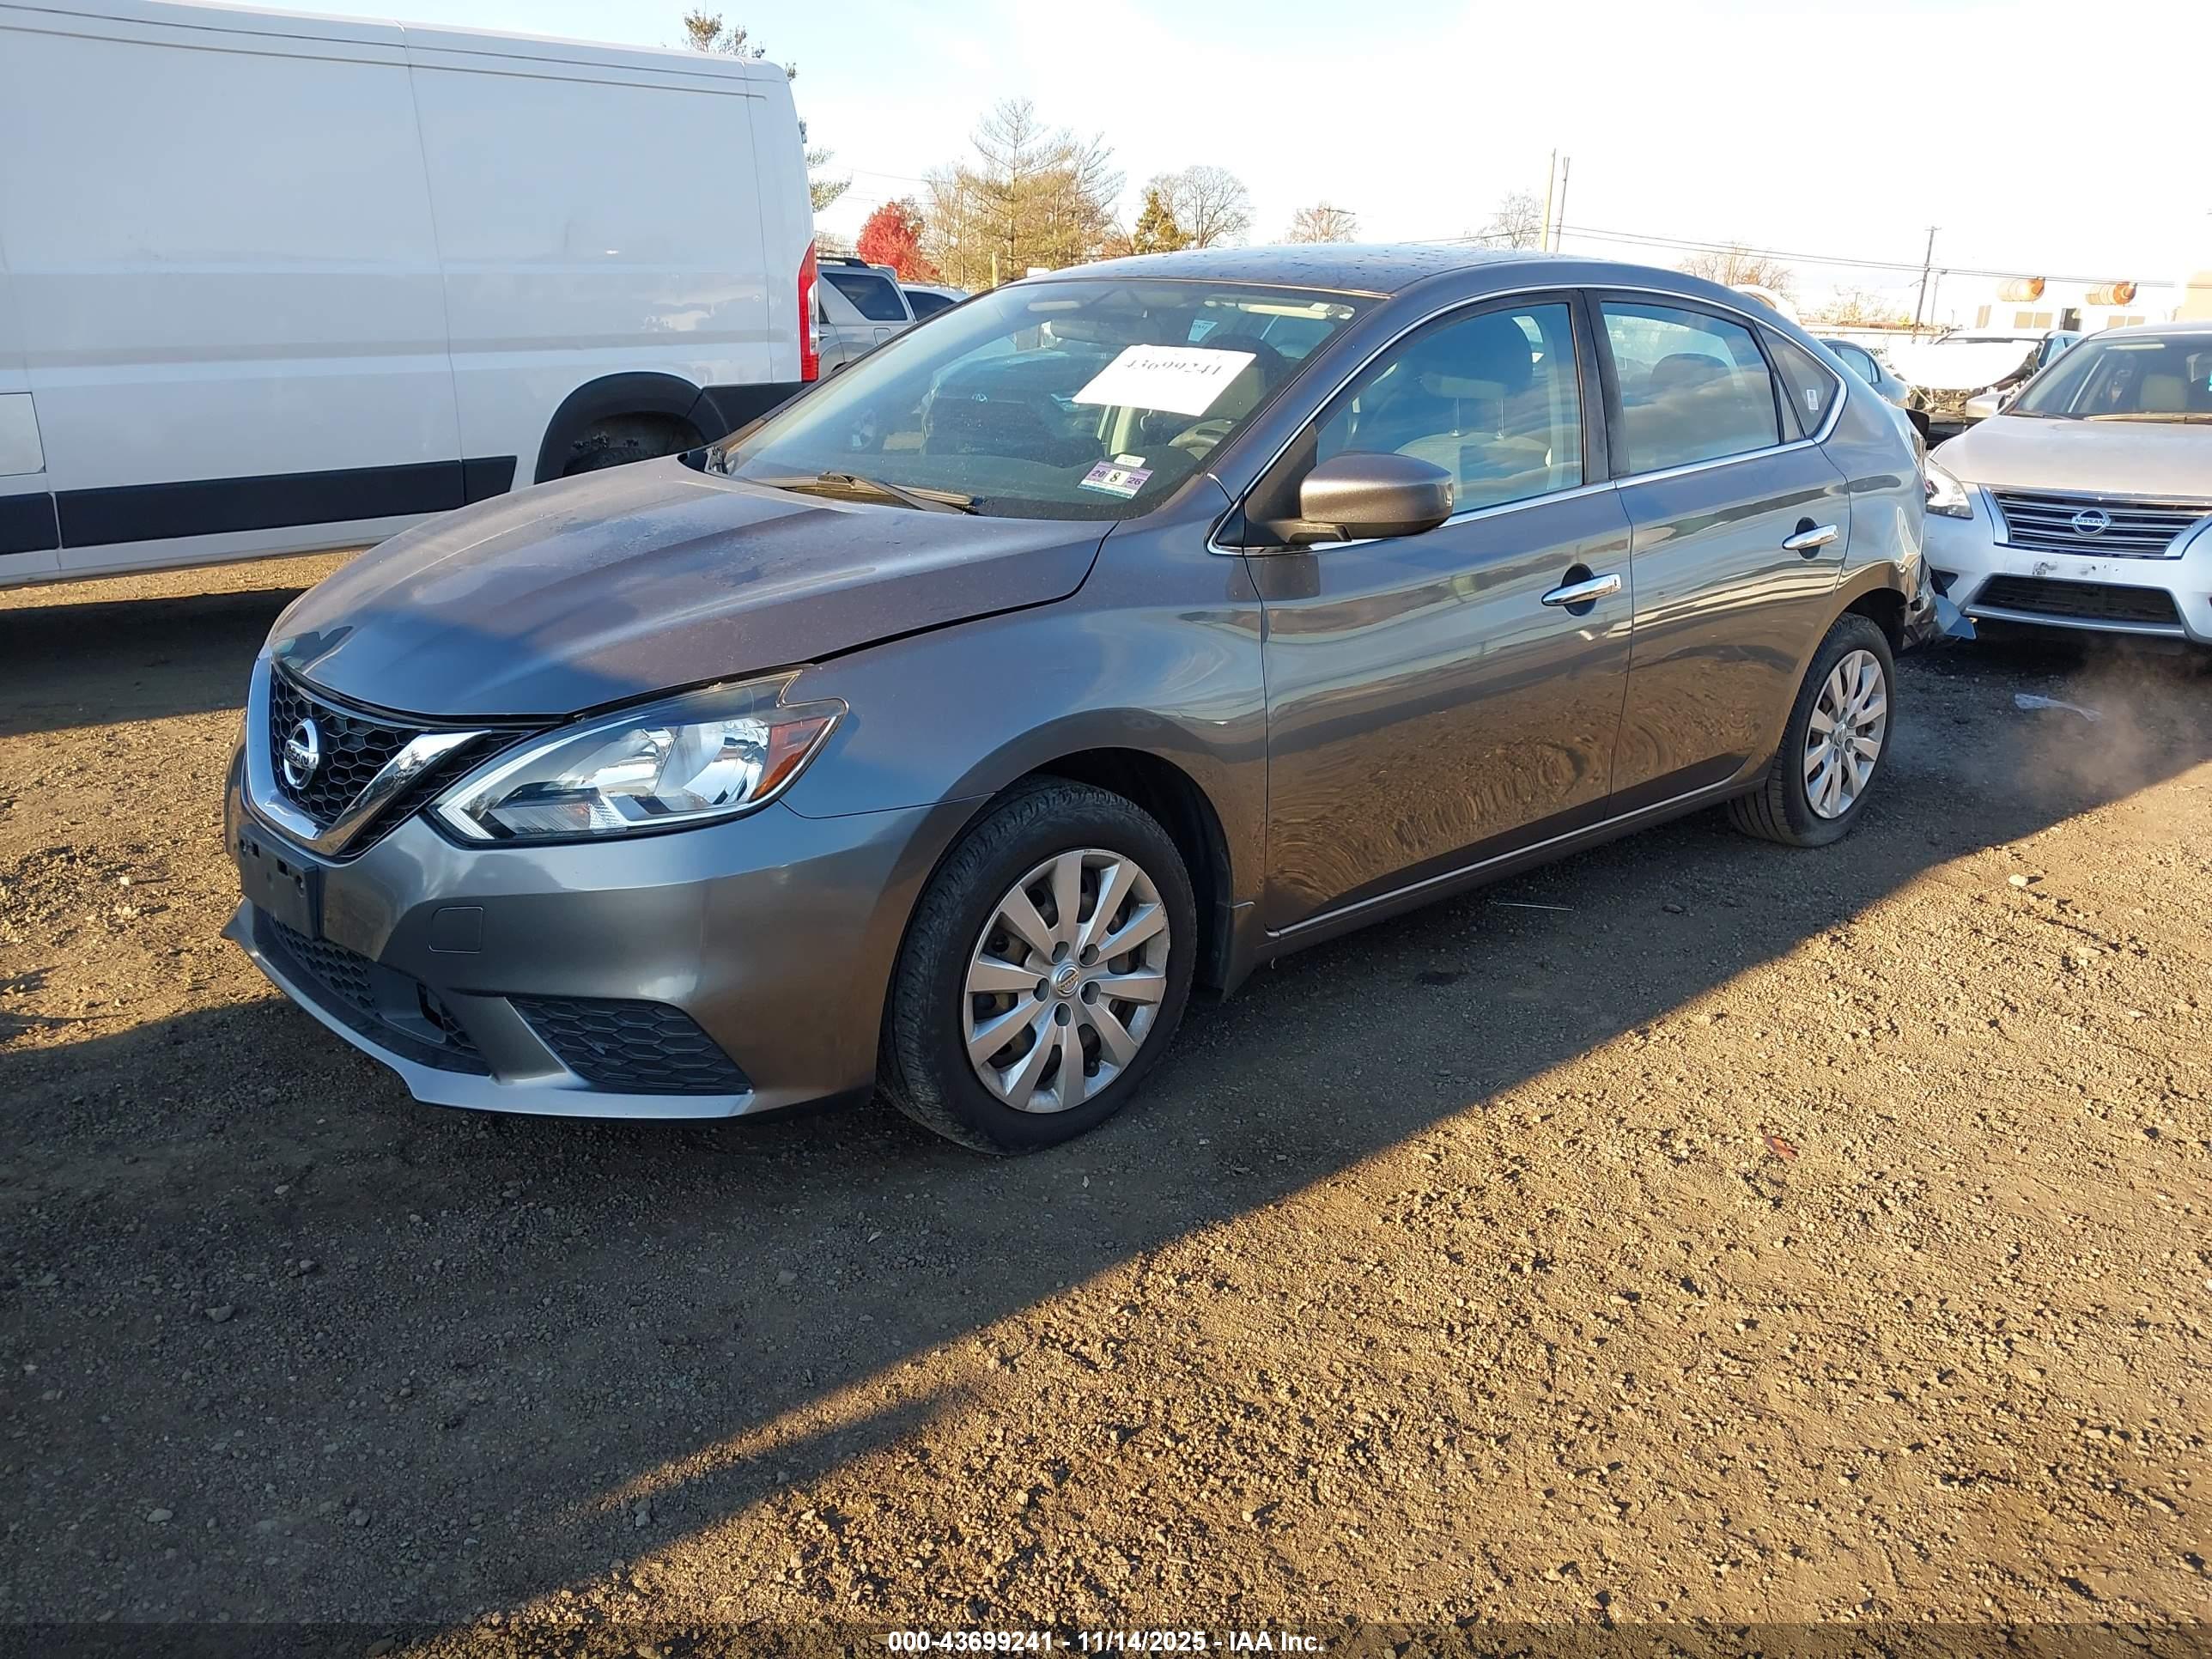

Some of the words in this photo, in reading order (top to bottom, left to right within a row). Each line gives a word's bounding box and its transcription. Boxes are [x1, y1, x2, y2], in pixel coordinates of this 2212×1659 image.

[1091, 470, 1106, 478] 20
[1109, 471, 1121, 483] 8
[1127, 477, 1141, 485] 26
